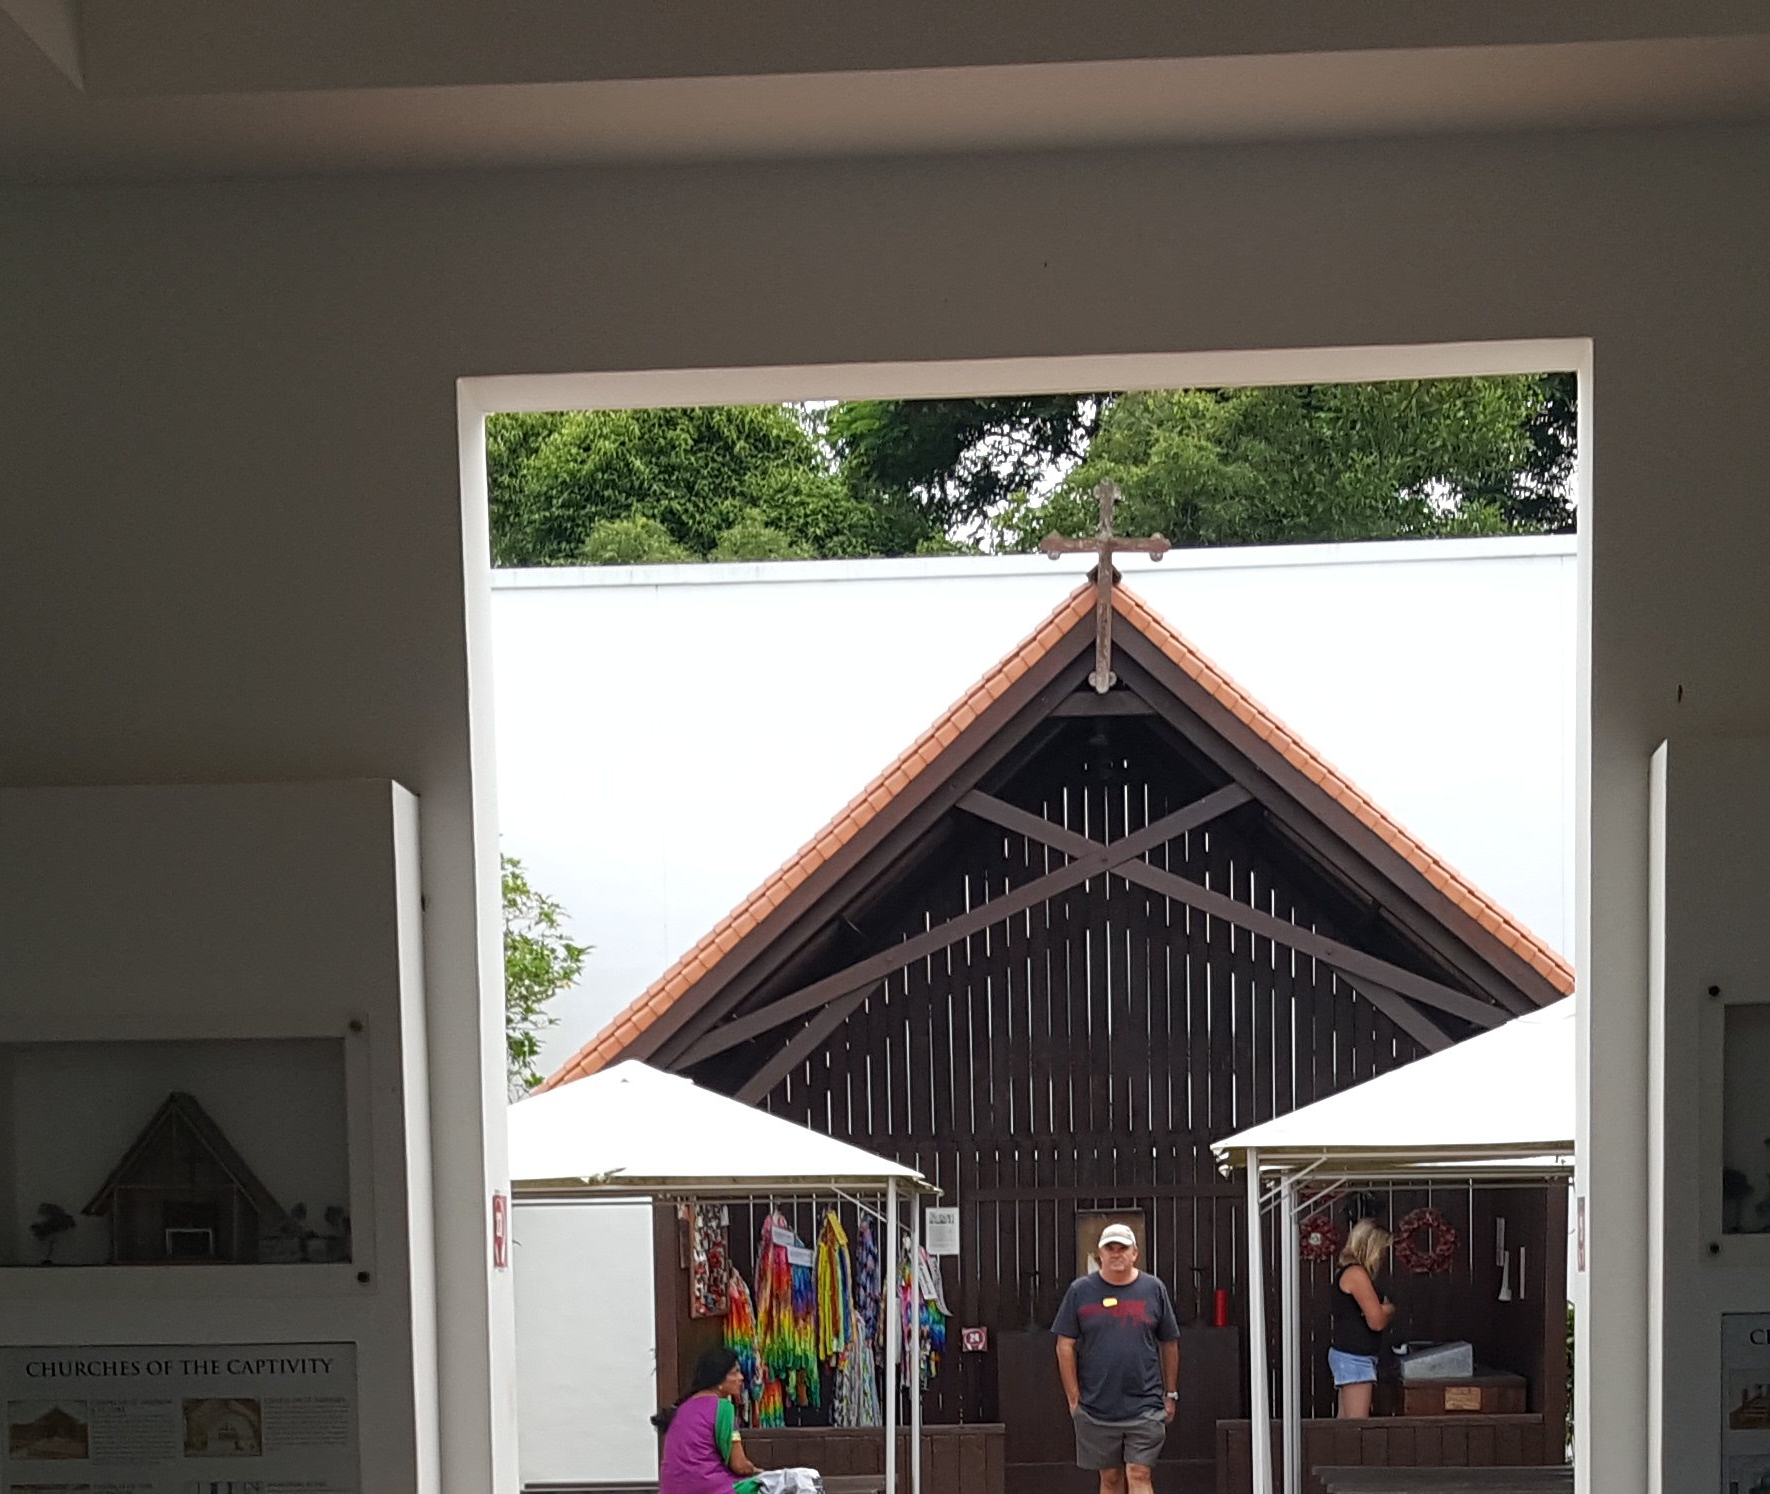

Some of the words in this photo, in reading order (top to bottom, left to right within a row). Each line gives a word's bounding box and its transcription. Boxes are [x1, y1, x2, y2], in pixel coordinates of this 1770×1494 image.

[25, 1360, 140, 1377] CHURCHES
[146, 1359, 173, 1376] OF
[180, 1359, 220, 1375] THE
[227, 1357, 333, 1375] CAPTIVITY
